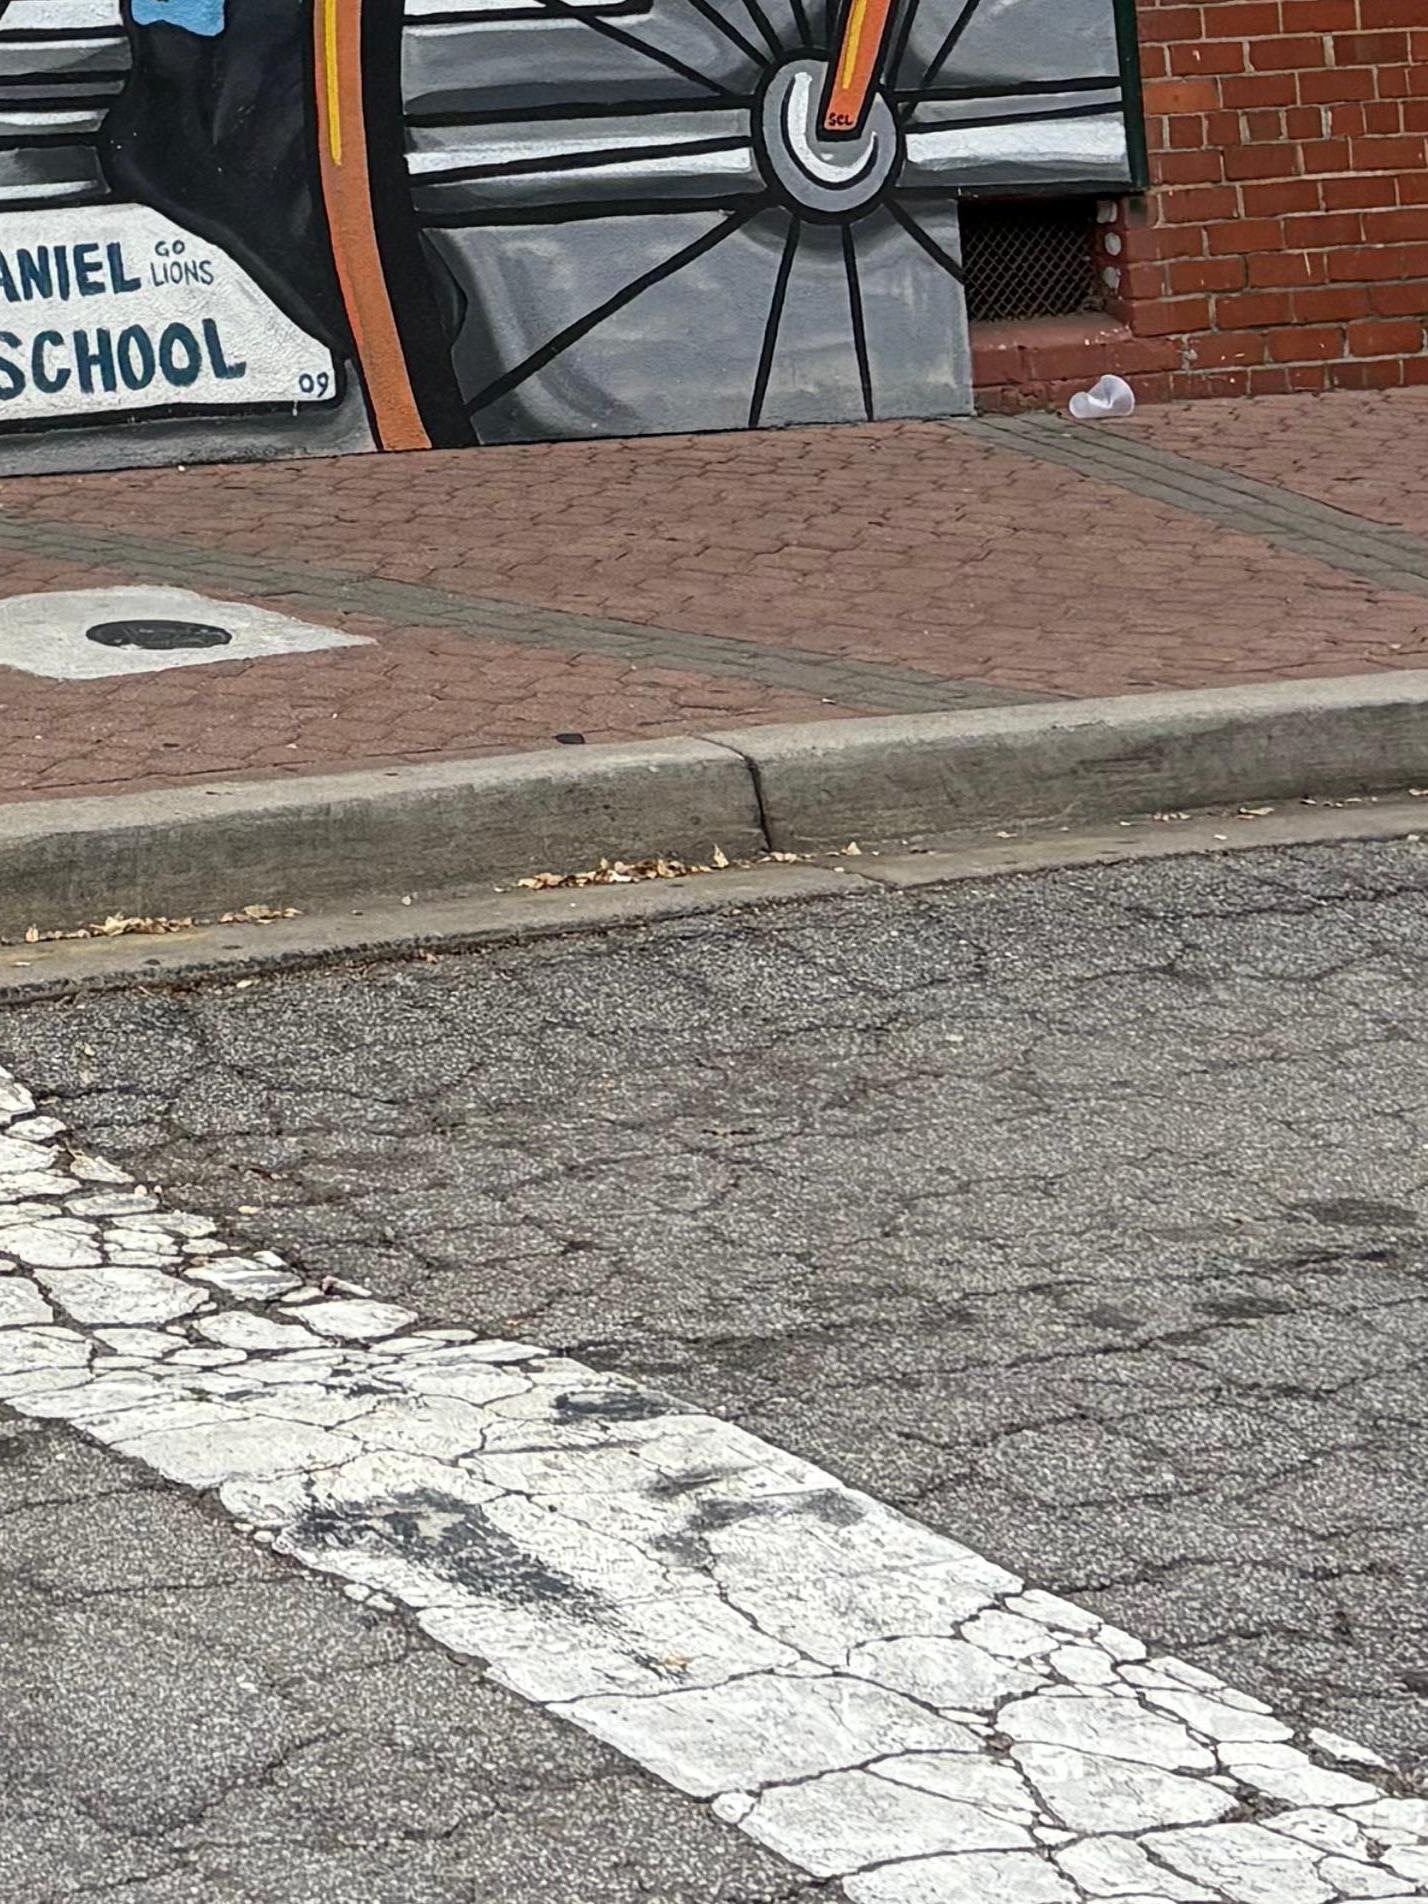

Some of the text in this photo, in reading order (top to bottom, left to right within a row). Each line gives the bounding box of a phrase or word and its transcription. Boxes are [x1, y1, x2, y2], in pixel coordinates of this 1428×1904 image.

[154, 239, 186, 258] GO
[150, 259, 215, 289] LIONS
[298, 372, 330, 400] 09
